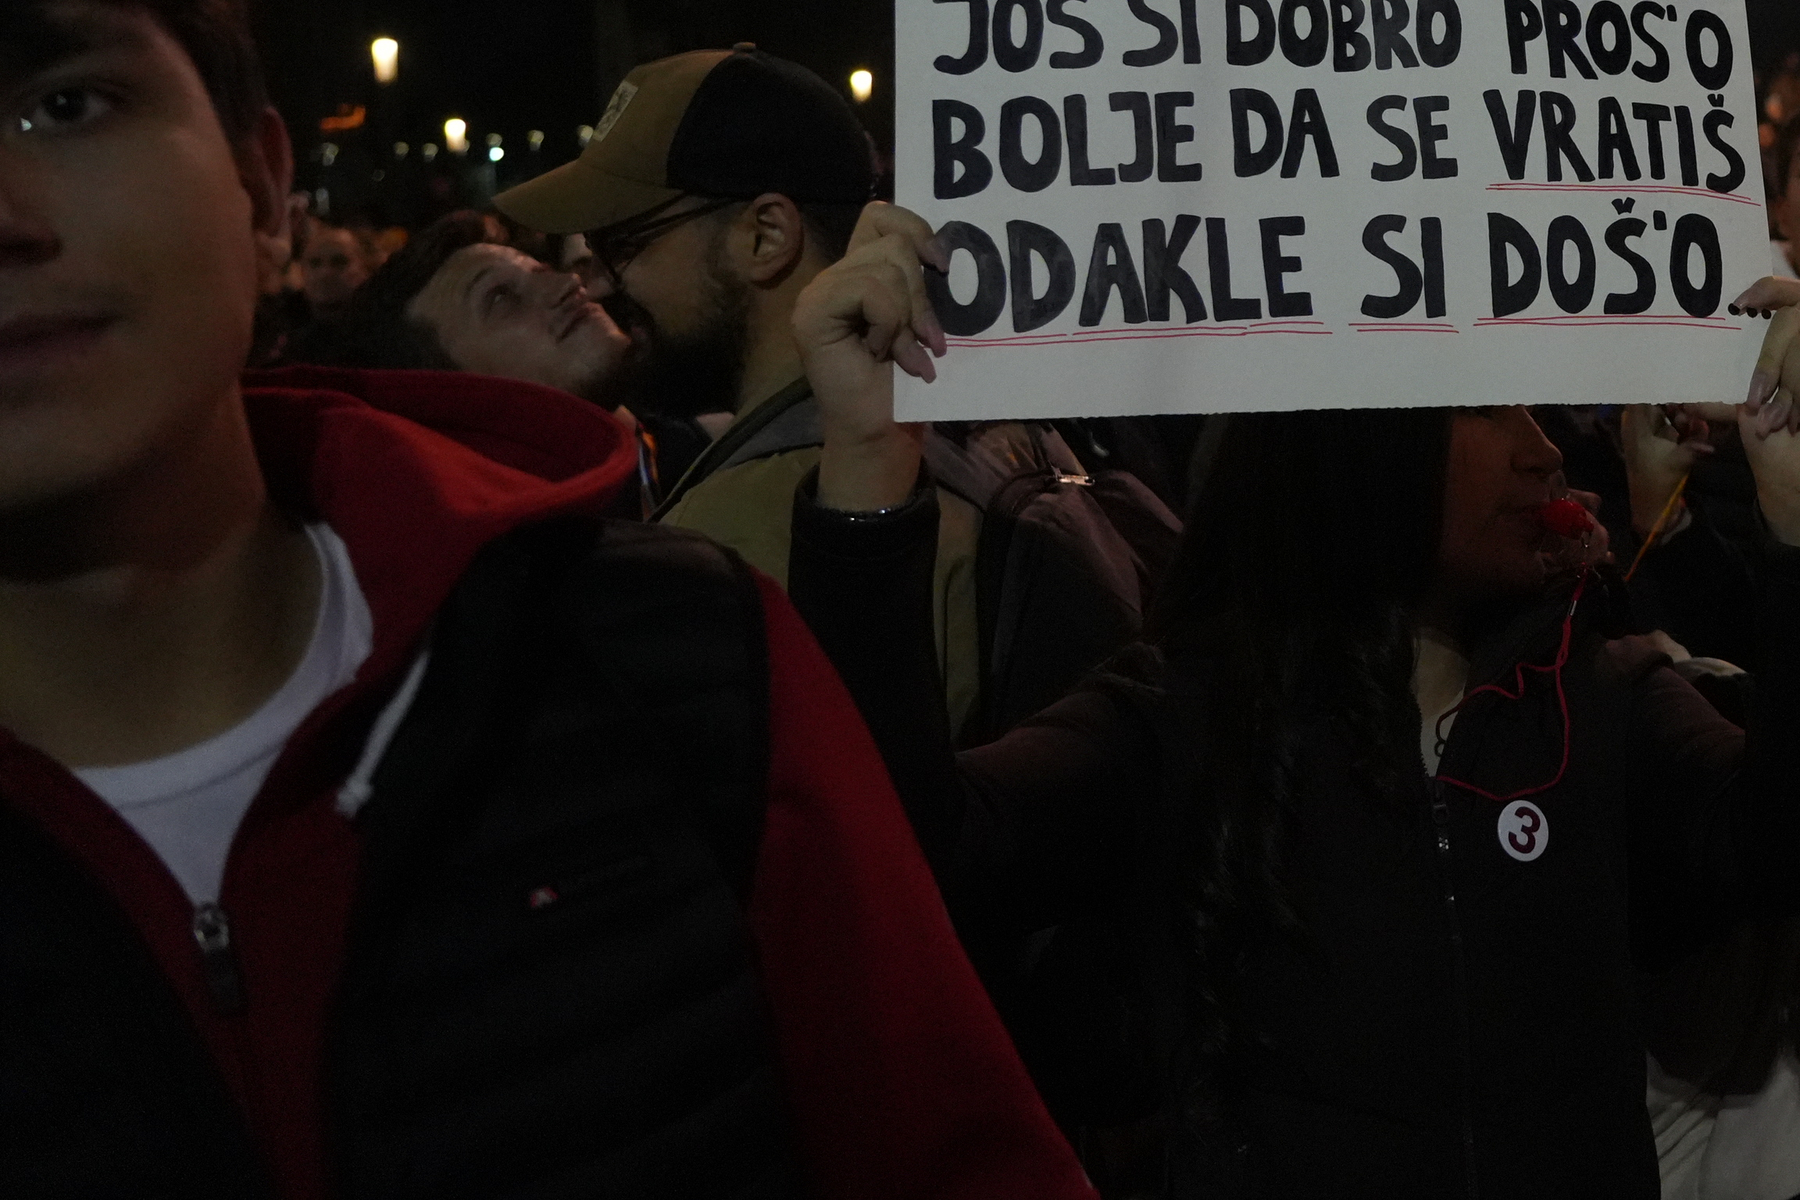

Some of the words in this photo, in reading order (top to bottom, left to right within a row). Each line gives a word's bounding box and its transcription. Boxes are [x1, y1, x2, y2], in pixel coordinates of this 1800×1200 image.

[932, 91, 1203, 200] BOLJE
[1230, 88, 1340, 179] DA
[1367, 95, 1460, 182] SE
[1484, 89, 1747, 194] VRATIŠ
[925, 214, 1315, 336] ODAKLE
[1361, 214, 1447, 319] SI
[1508, 806, 1541, 854] 3
